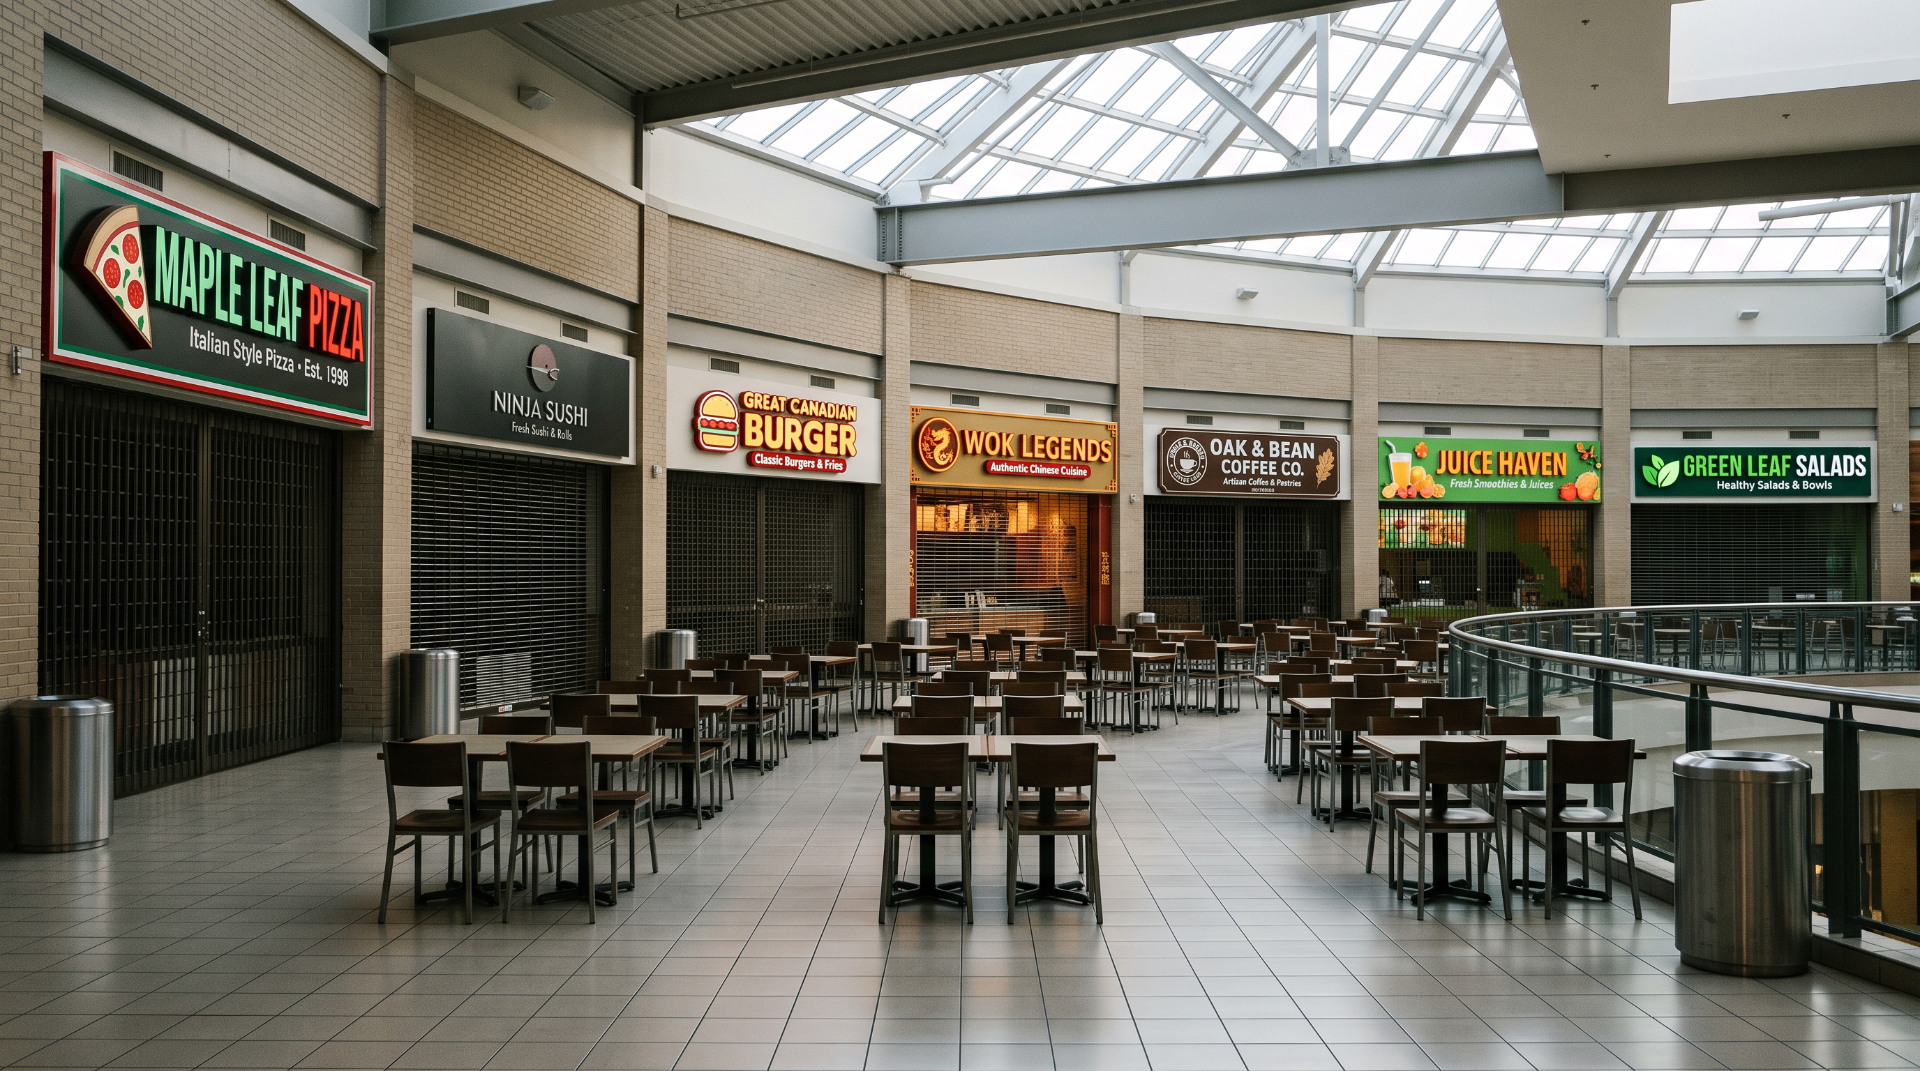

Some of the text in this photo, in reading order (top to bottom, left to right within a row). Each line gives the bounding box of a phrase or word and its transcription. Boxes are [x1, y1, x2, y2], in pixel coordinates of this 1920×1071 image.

[155, 225, 364, 363] MAPLE LEAF PIZZA
[190, 326, 230, 357] Italian
[233, 339, 263, 366] Style
[266, 347, 294, 373] Pizza
[304, 358, 323, 381] Est.
[327, 365, 349, 387] 1998
[494, 390, 588, 427] NINJA SUSHI
[743, 391, 857, 422] GREAT CANADIAN
[511, 421, 573, 441] Fresh Sushi & Rolls
[744, 412, 857, 457] BURGER
[964, 429, 1112, 463] WOK LEGENDS
[1210, 438, 1248, 457] OAK
[1251, 439, 1264, 458] &
[1269, 440, 1315, 460] BEAN
[754, 453, 843, 471] Classic Burgers & Fries
[990, 461, 1088, 477] Authentic Chinese Cuisine
[1221, 459, 1305, 477] COFFEE CO.
[1436, 450, 1567, 476] JUICE HAVEN
[1683, 454, 1867, 477] GREEN LEAF SALADS
[1270, 478, 1275, 486] &
[1450, 478, 1554, 489] Fresh Smoothies & Juices
[1716, 480, 1833, 492] Healthy Salads & Bowls
